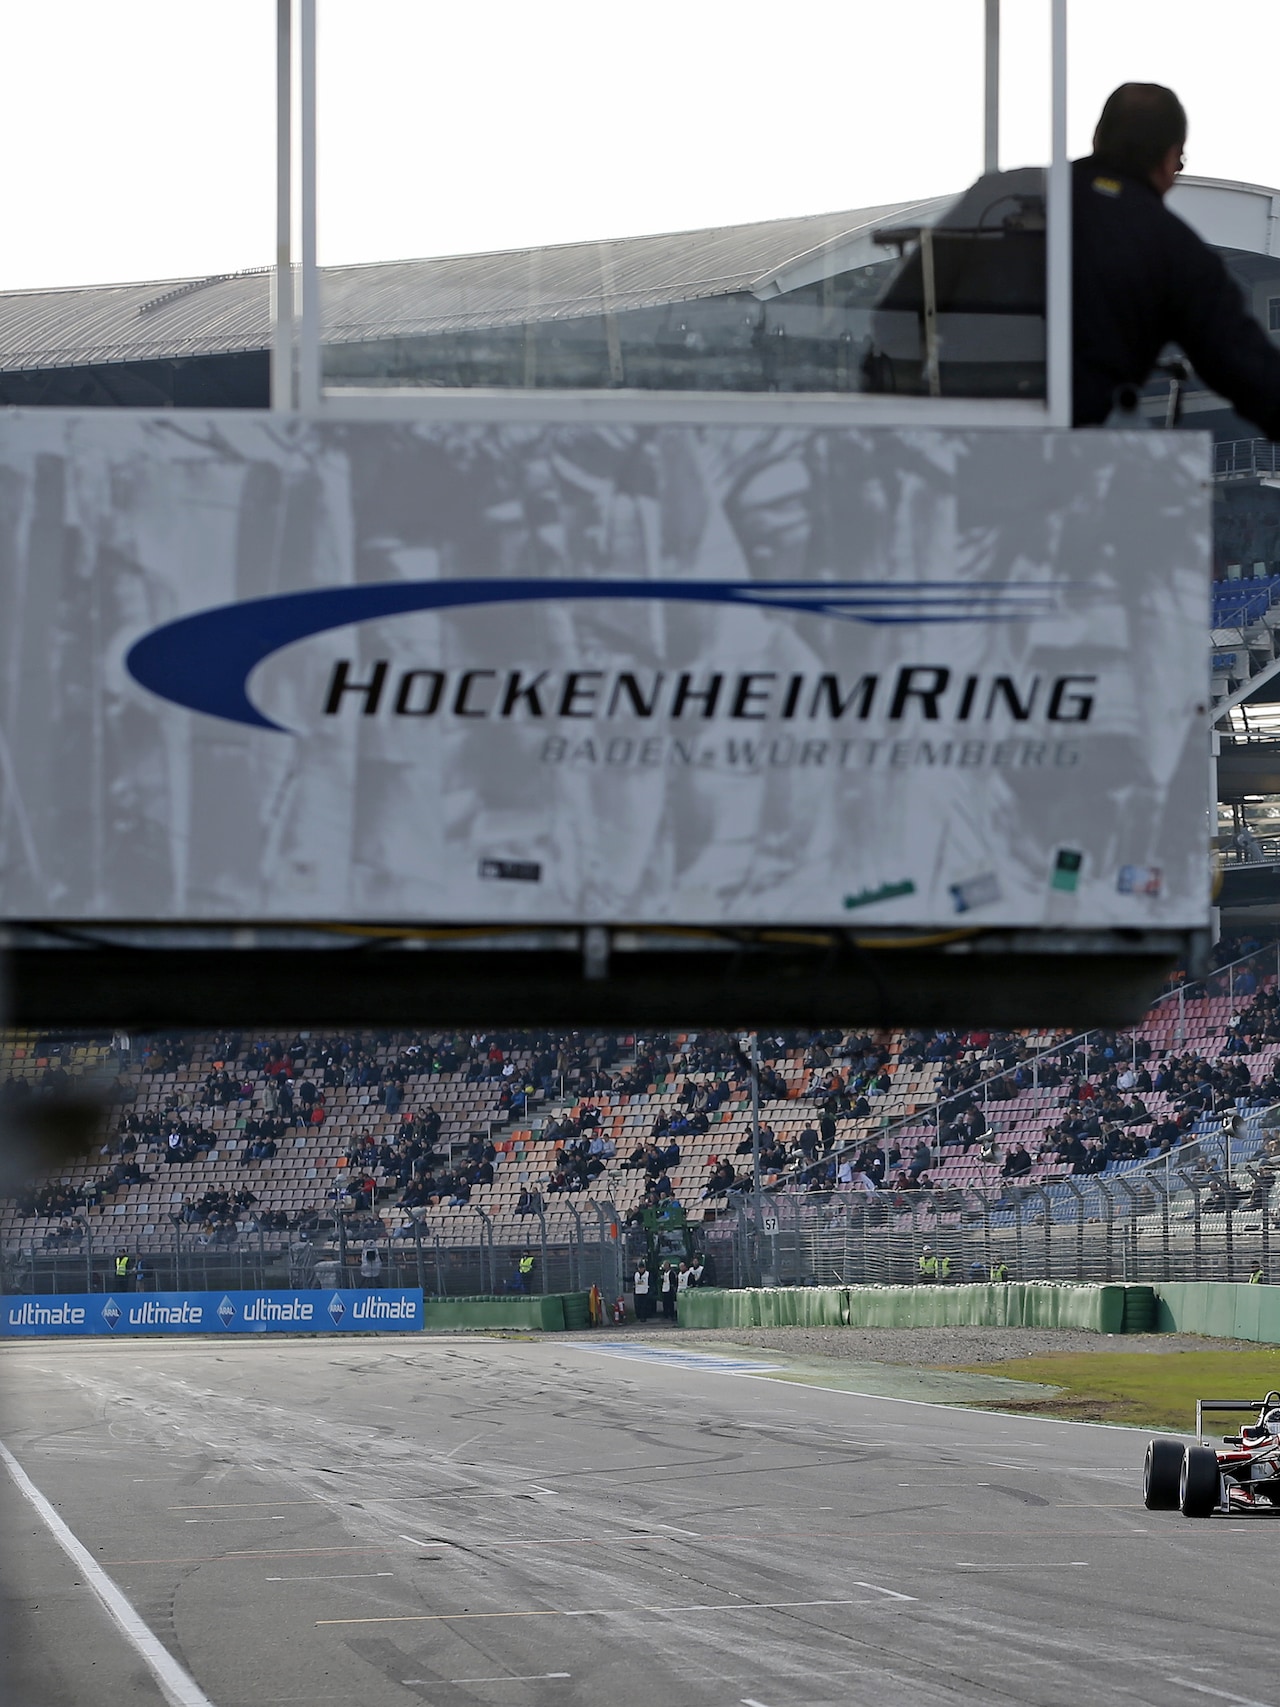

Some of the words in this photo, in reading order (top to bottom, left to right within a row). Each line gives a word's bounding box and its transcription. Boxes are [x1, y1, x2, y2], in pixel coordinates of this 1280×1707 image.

[323, 659, 1097, 723] HOCKENHEIMRING
[765, 1218, 776, 1230] 57
[9, 1302, 86, 1325] ultimate
[104, 1307, 120, 1317] ARAL
[129, 1301, 203, 1324] ultimate
[219, 1306, 234, 1316] ARAL
[243, 1297, 314, 1321] ultimate
[330, 1304, 344, 1313] ARAL
[352, 1295, 416, 1319] ultimate
